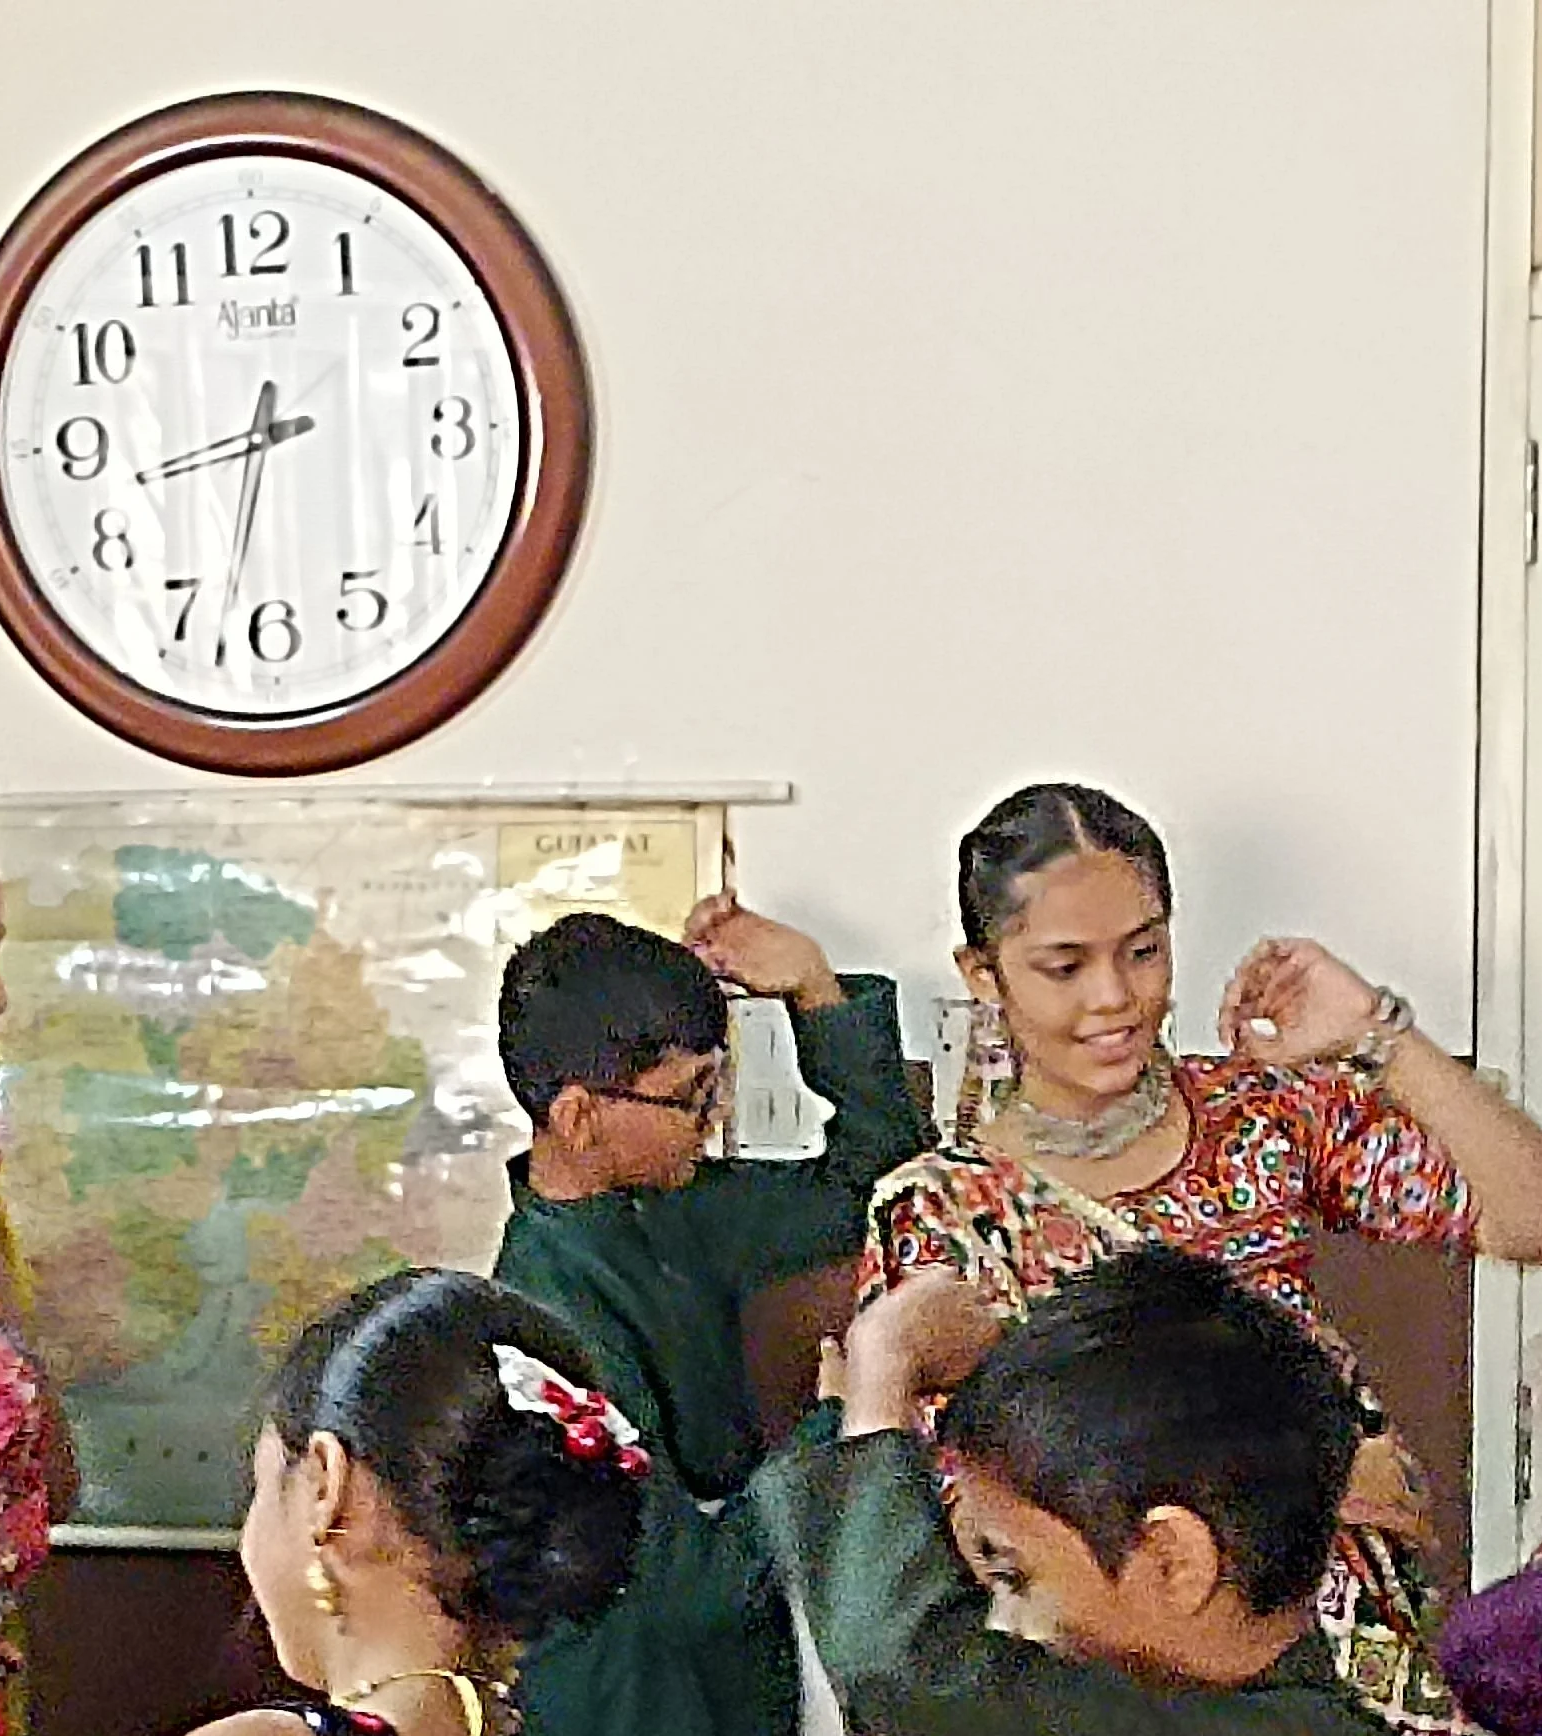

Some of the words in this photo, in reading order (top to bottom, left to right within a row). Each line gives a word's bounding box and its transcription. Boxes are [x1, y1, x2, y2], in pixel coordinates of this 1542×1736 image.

[133, 242, 195, 308] 11
[218, 209, 291, 278] 12
[333, 231, 359, 297] 1
[70, 319, 137, 386] 10
[401, 302, 441, 368] 2
[55, 415, 110, 481] 9
[430, 395, 476, 461] 3
[91, 507, 135, 572] 8
[407, 492, 445, 556] 4
[164, 577, 202, 642] 7
[248, 599, 302, 663] 6
[335, 569, 389, 632] 5
